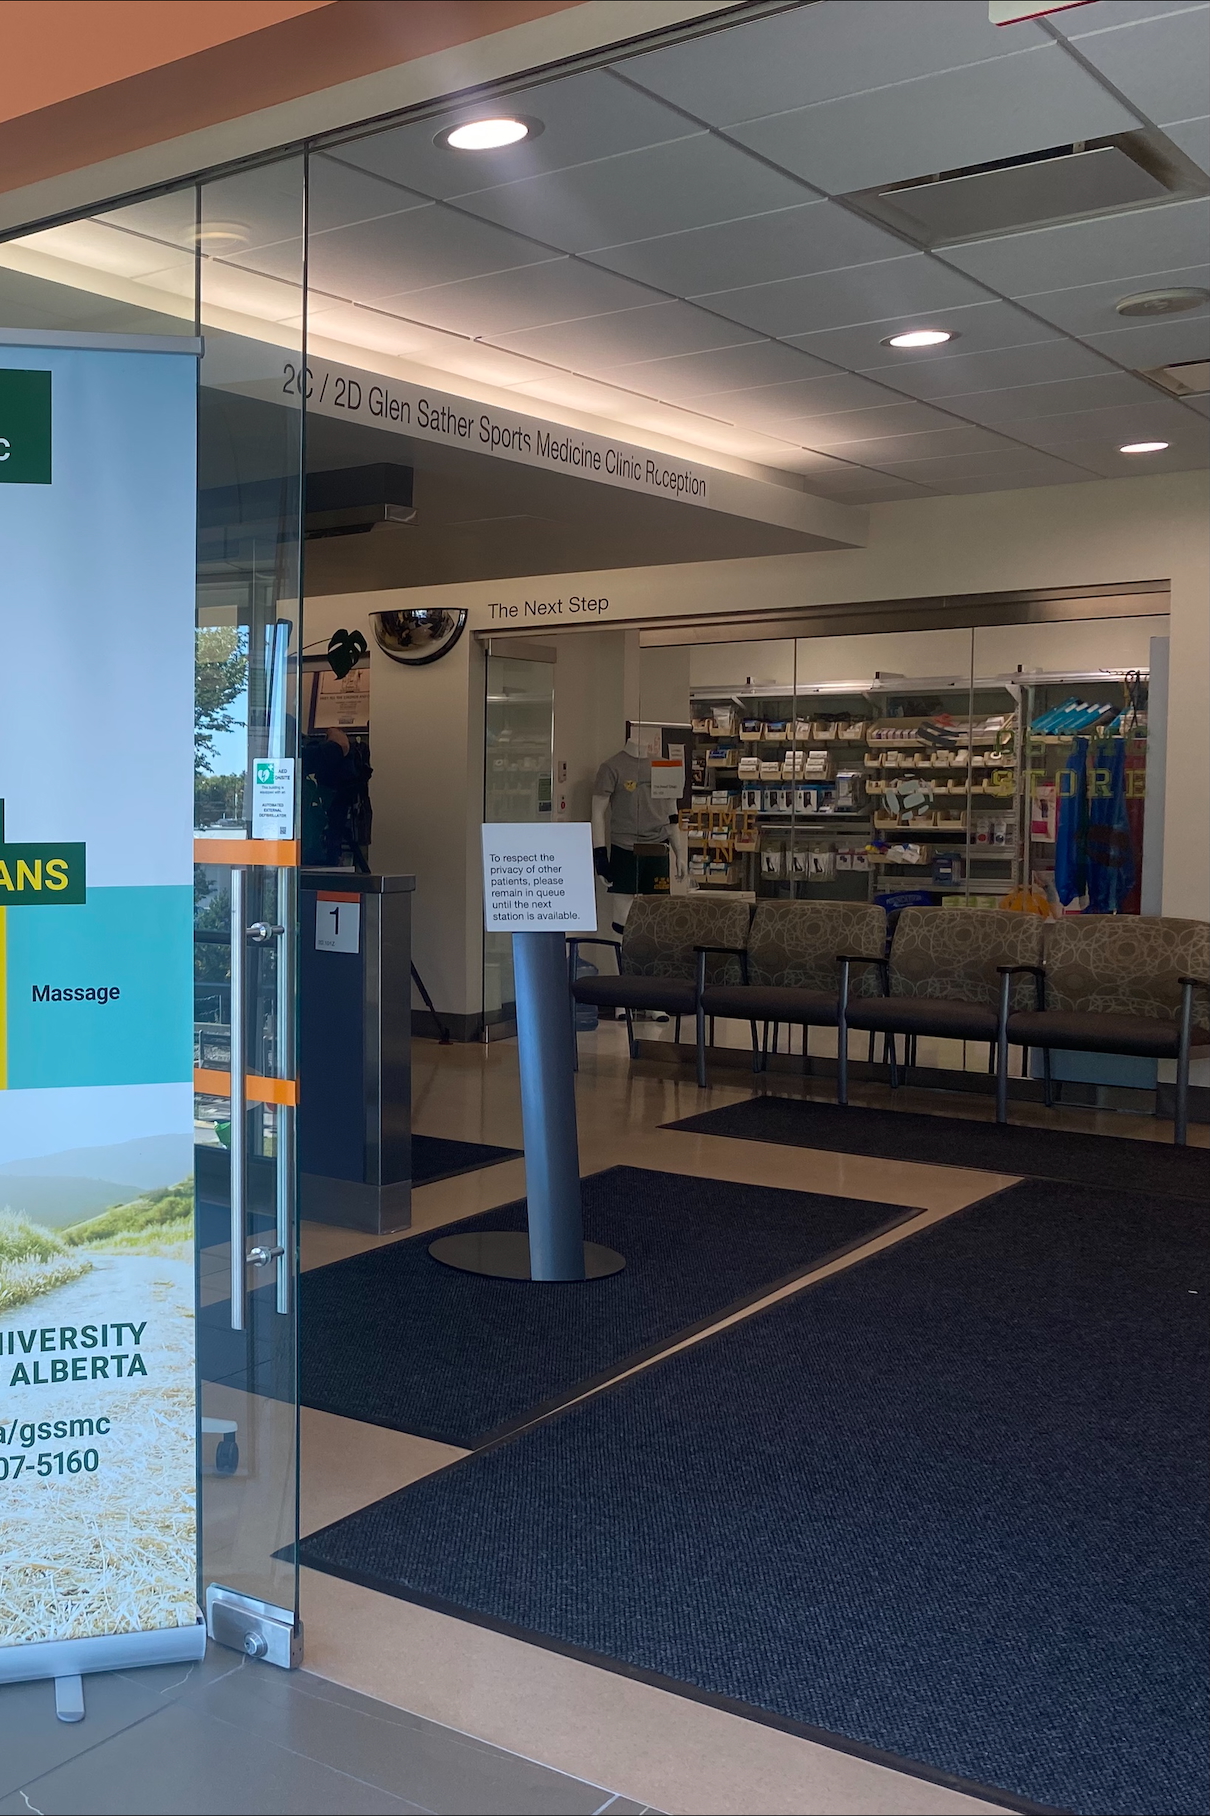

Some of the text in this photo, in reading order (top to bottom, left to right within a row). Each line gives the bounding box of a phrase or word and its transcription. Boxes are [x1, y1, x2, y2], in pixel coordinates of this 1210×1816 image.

[283, 364, 314, 399] 2C
[319, 374, 329, 402] /
[334, 377, 362, 410] 2D
[369, 387, 411, 425] Glen
[417, 399, 474, 440] Sather
[479, 416, 531, 453] Sports
[536, 430, 601, 470] Medicine
[605, 450, 641, 481] Clinic
[488, 596, 609, 619] The Next Step
[991, 767, 1147, 799] STORE
[490, 853, 555, 864] To respect the
[490, 864, 562, 876] privacy of other
[491, 876, 564, 887] patients, please
[491, 889, 566, 898] remain in queue
[492, 900, 552, 909] until the next
[329, 906, 339, 935] 1
[492, 911, 580, 921] station is available.
[31, 984, 121, 1006] Massage
[9, 1353, 148, 1387] ALBERTA
